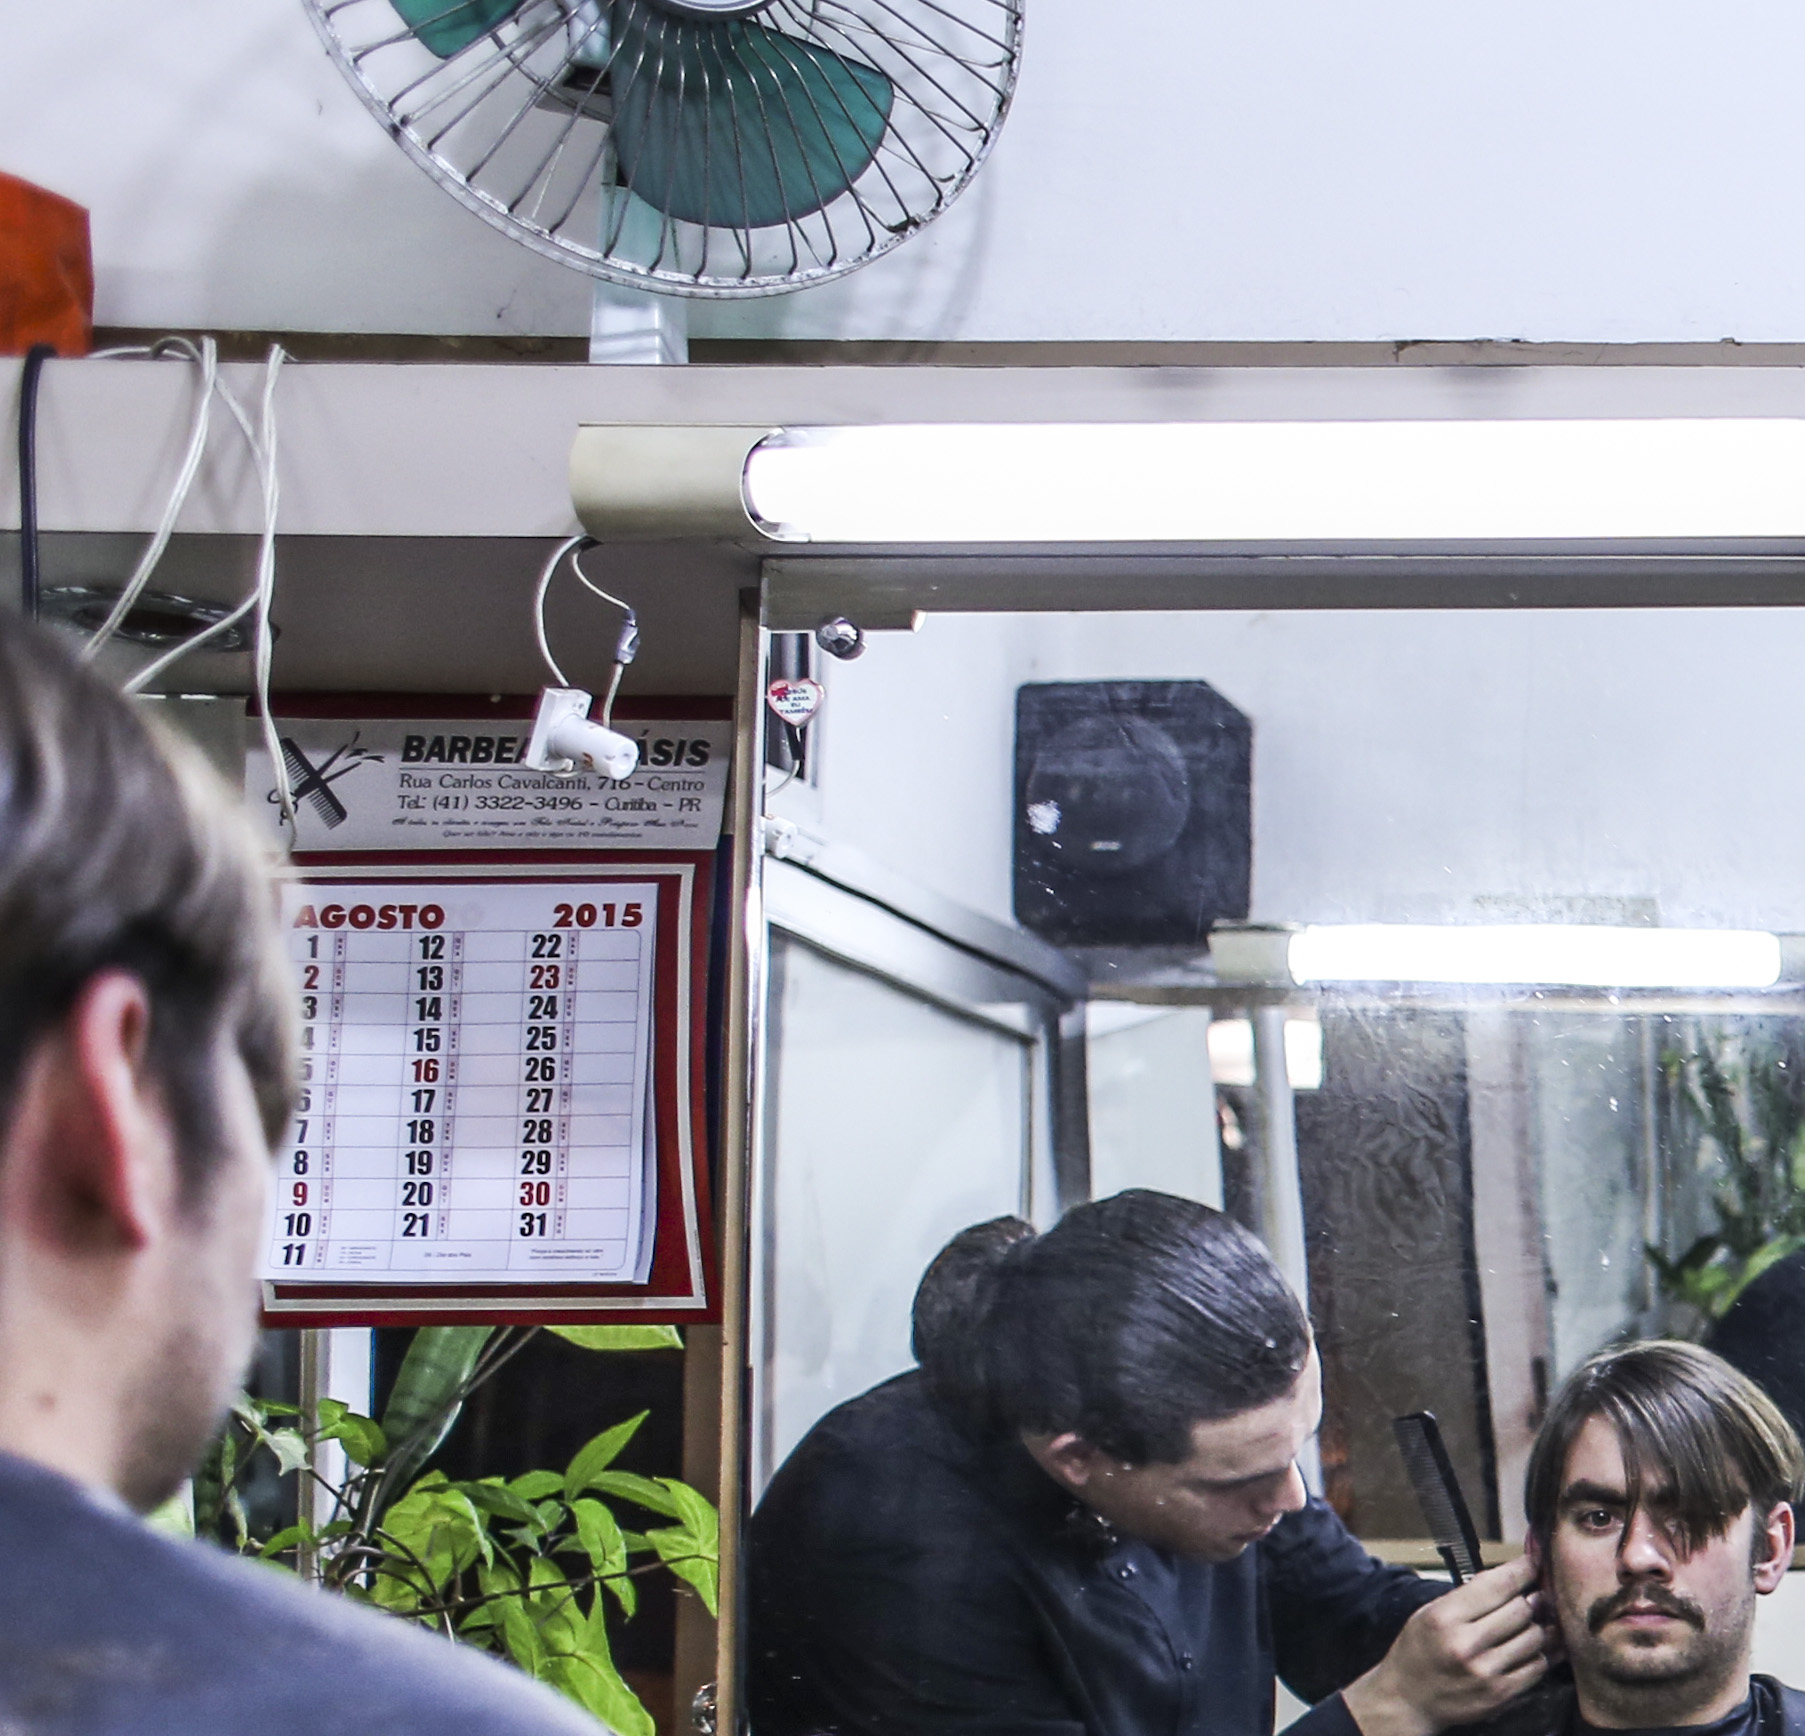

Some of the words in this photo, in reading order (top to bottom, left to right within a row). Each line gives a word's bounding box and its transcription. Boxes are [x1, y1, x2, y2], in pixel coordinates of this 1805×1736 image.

[400, 774, 431, 790] Rua
[439, 774, 491, 790] Carlos
[647, 777, 705, 792] Centro
[433, 794, 468, 811] (41)
[475, 796, 582, 811] 3322-3496
[678, 798, 701, 812] PR
[293, 904, 445, 930] AGOSTO
[553, 902, 643, 927] 2015
[307, 935, 320, 959] 1
[418, 935, 445, 960] 12
[532, 934, 561, 959] 22
[304, 965, 320, 990] 2
[416, 966, 443, 991] 13
[529, 965, 560, 989] 23
[302, 996, 318, 1020] 3
[415, 997, 442, 1022] 14
[528, 996, 558, 1020] 24
[413, 1028, 441, 1053] 15
[526, 1026, 557, 1051] 25
[411, 1059, 439, 1083] 16
[525, 1057, 556, 1082] 26
[410, 1089, 436, 1113] 17
[526, 1088, 553, 1113] 27
[296, 1119, 309, 1143] 7
[406, 1120, 434, 1144] 18
[523, 1119, 552, 1144] 28
[293, 1150, 309, 1175] 8
[405, 1150, 433, 1175] 19
[521, 1150, 551, 1175] 29
[292, 1181, 308, 1206] 9
[402, 1181, 433, 1206] 20
[519, 1181, 550, 1206] 30
[284, 1213, 312, 1237] 10
[402, 1213, 430, 1237] 21
[519, 1213, 546, 1237] 31
[282, 1244, 307, 1265] 11
